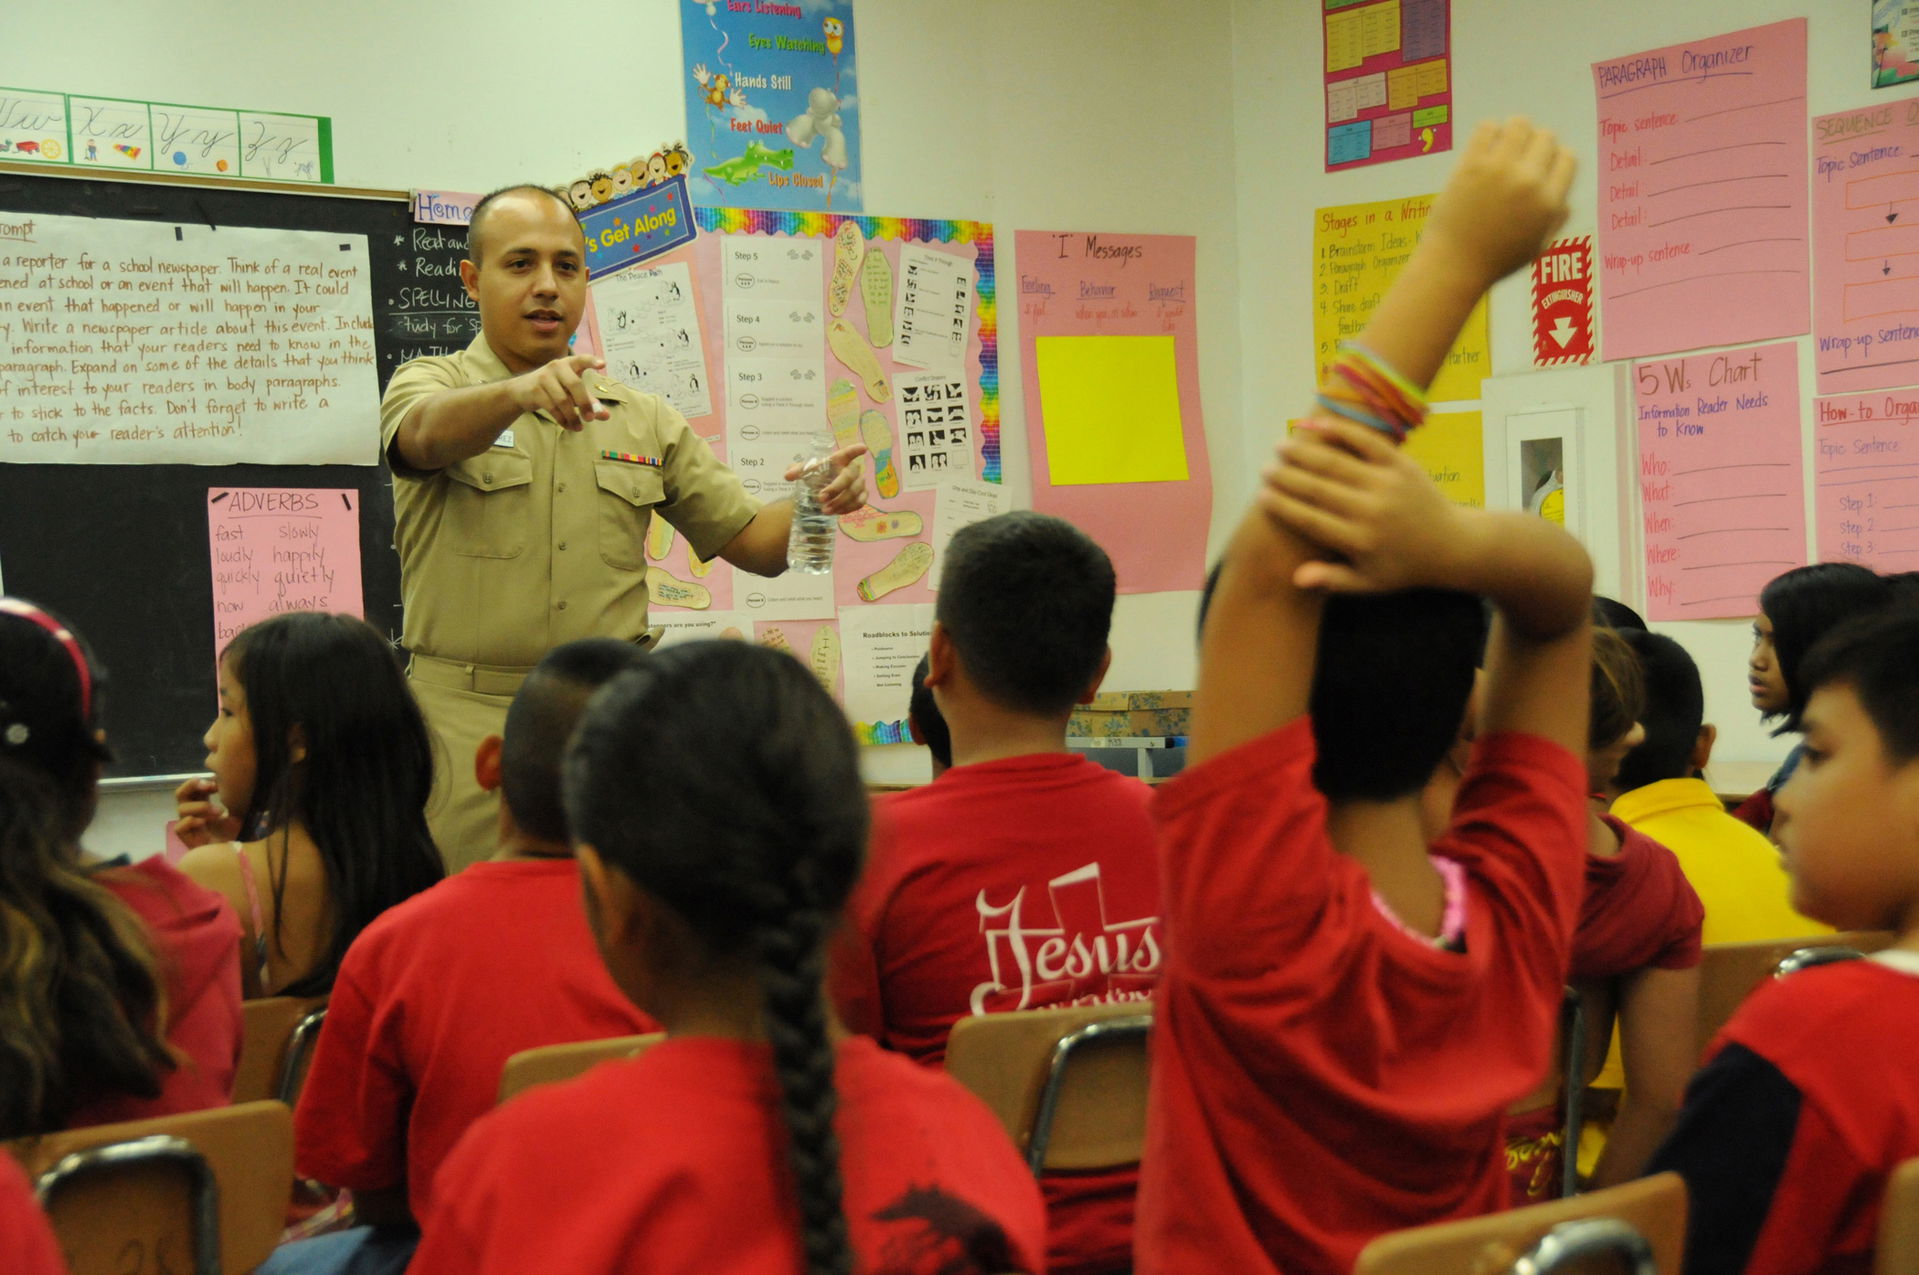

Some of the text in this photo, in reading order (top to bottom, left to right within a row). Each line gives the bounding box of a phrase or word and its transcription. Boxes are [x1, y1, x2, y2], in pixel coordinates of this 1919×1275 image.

[755, 0, 803, 19] Listening
[749, 33, 827, 56] Eyes Watching
[1598, 45, 1754, 89] PARAGRAPH Organizer
[735, 72, 792, 92] Hands Still
[731, 118, 783, 136] Feet Quiet
[1601, 117, 1629, 143] Topic
[768, 171, 823, 189] Lips Closed
[1815, 156, 1845, 183] Topic
[600, 223, 631, 247] Get
[634, 207, 677, 237] Along
[1320, 210, 1393, 238] Stages in a
[735, 250, 759, 262] Step 5
[1084, 235, 1143, 270] Messages
[16, 253, 68, 275] reporter
[78, 252, 97, 271] for
[119, 256, 153, 273] school
[227, 256, 262, 275] Think
[264, 258, 281, 275] of
[298, 261, 324, 279] real
[328, 265, 359, 281] event
[1541, 251, 1583, 284] FIRE
[37, 274, 57, 291] at
[58, 275, 94, 291] school
[100, 279, 115, 291] or
[119, 278, 134, 291] an
[138, 278, 174, 292] event
[181, 277, 214, 294] that
[219, 280, 242, 296] will
[293, 279, 312, 296] It
[314, 281, 351, 297] could
[17, 297, 321, 321] event that happened or will happen your
[398, 286, 476, 311] SPELLING
[21, 317, 60, 336] Write
[82, 321, 154, 344] newspaper
[160, 321, 208, 336] article
[215, 319, 257, 335] about
[264, 319, 288, 334] this
[736, 313, 760, 327] Step 4
[12, 334, 373, 361] information that your readers need know the
[71, 358, 118, 383] Expand
[122, 362, 139, 374] on
[145, 358, 180, 373] some
[185, 353, 201, 371] of
[207, 355, 228, 371] the
[233, 354, 279, 371] details
[282, 352, 313, 367] that
[316, 355, 340, 372] you
[341, 350, 375, 367] think
[738, 371, 763, 385] Step 3
[1638, 363, 1660, 396] 5
[1708, 351, 1763, 387] Chart
[17, 379, 75, 398] interest
[83, 380, 98, 397] to
[101, 381, 132, 401] your
[142, 378, 196, 396] readers
[203, 378, 218, 395] in
[226, 375, 257, 396] body
[12, 407, 26, 420] to
[31, 404, 64, 422] stick
[73, 402, 88, 418] to
[91, 400, 113, 417] the
[166, 398, 199, 416] Don't
[206, 398, 248, 424] forget
[273, 394, 309, 412] write
[1638, 391, 1768, 421] Information Reader Needs
[8, 427, 25, 443] to
[31, 426, 69, 443] catch
[110, 425, 166, 443] reader's
[1657, 419, 1705, 437] to Know
[740, 456, 765, 470] Step 2
[228, 491, 319, 512] ADVERBS
[1839, 496, 1864, 517] Step
[215, 521, 320, 546] fast slowly
[1840, 521, 1864, 540] Step
[216, 543, 325, 573] loudly happily
[1840, 544, 1863, 562] Step
[216, 565, 334, 599] quickly quietly
[217, 594, 327, 613] now always
[863, 630, 909, 640] Roadblocks to
[970, 885, 1163, 1015] Jesus
